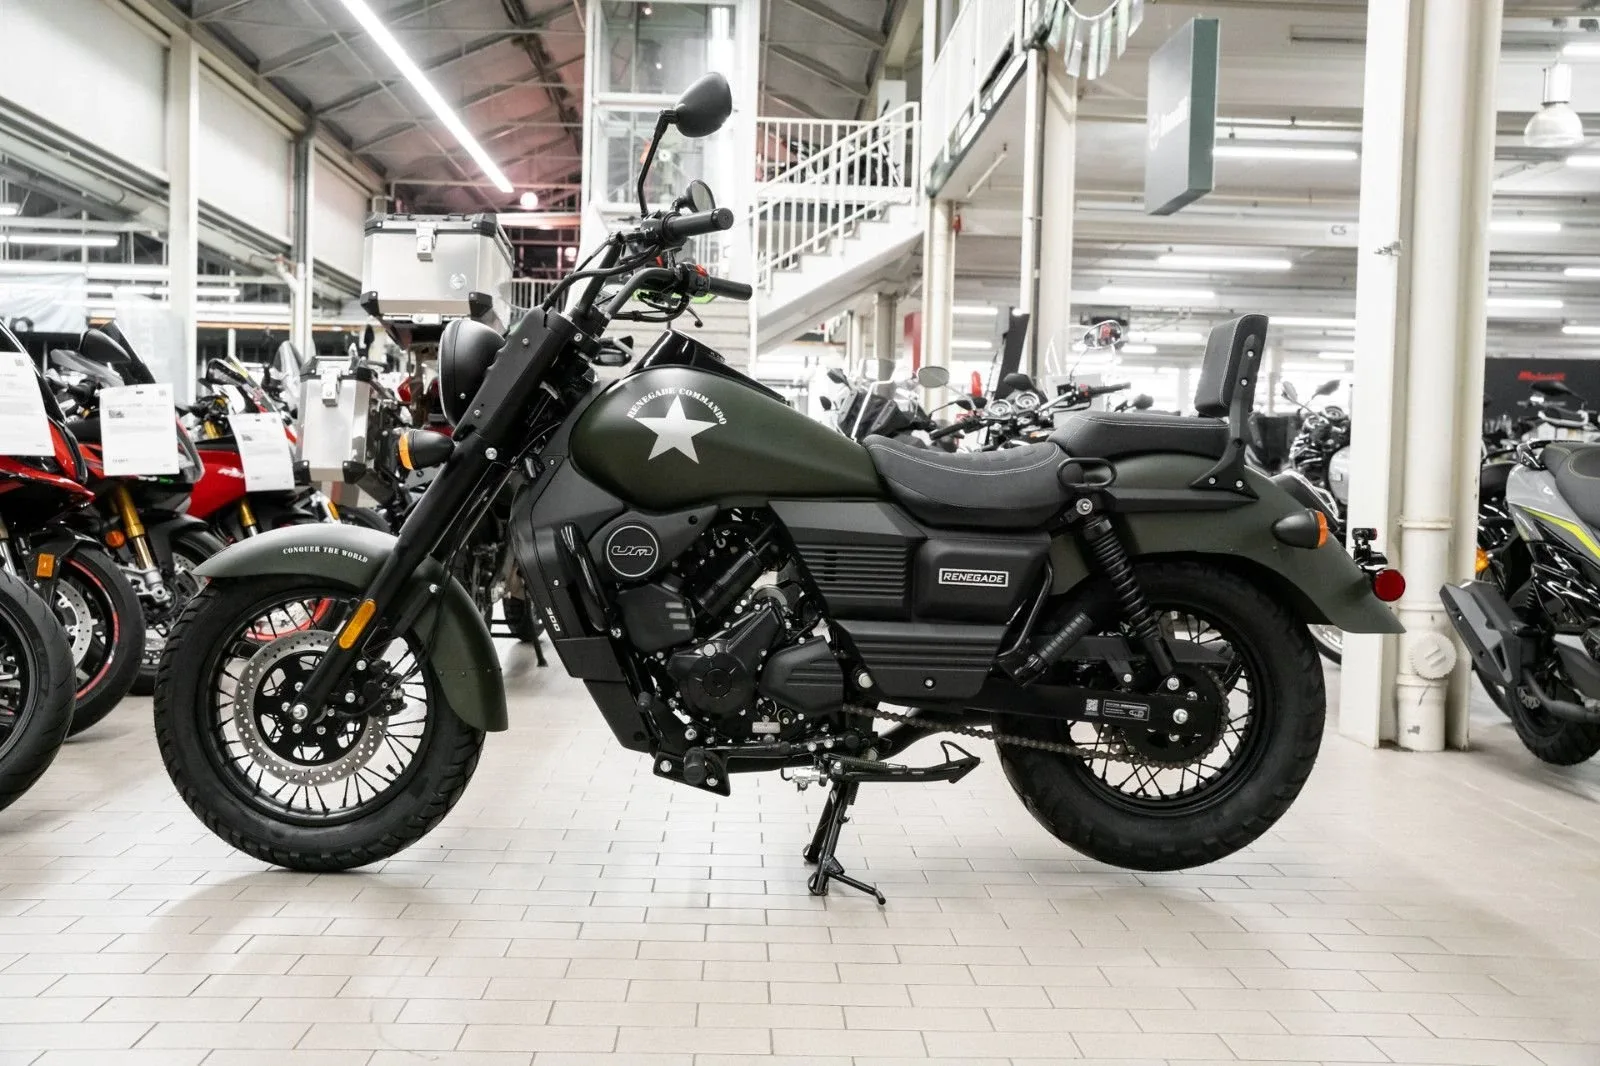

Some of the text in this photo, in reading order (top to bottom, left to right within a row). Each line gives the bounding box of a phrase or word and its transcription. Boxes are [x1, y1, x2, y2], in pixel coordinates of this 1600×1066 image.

[626, 387, 728, 425] RENEGADE COMMANDO
[282, 545, 369, 564] CONQUER THE WORLD
[943, 572, 1005, 583] RENEGADE
[545, 606, 561, 632] 300
